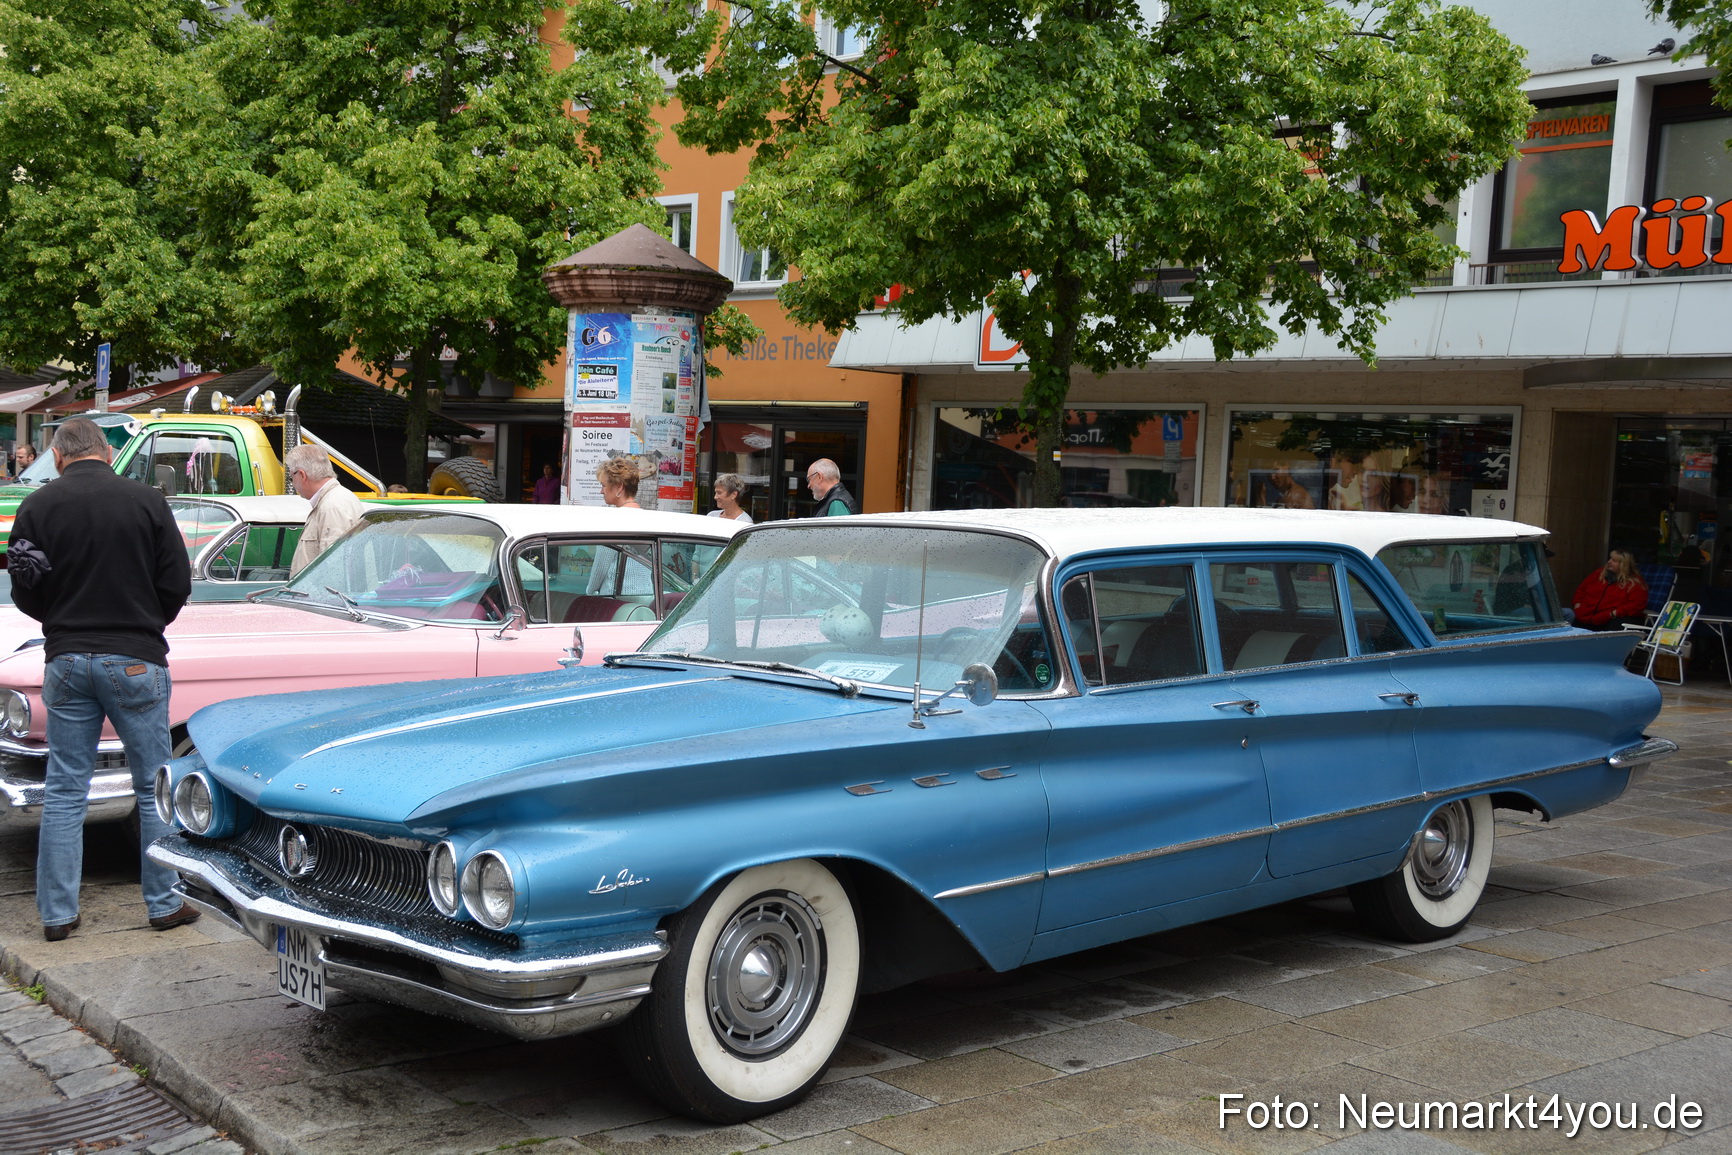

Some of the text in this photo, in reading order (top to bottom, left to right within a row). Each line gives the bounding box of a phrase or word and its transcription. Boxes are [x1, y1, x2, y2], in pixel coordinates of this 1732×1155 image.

[1524, 114, 1610, 139] SPIELWAREN
[781, 334, 837, 361] Theke
[99, 350, 107, 384] P
[595, 366, 614, 375] Café
[582, 430, 613, 440] Soiree
[286, 926, 308, 964] NM
[279, 957, 322, 1005] US7H
